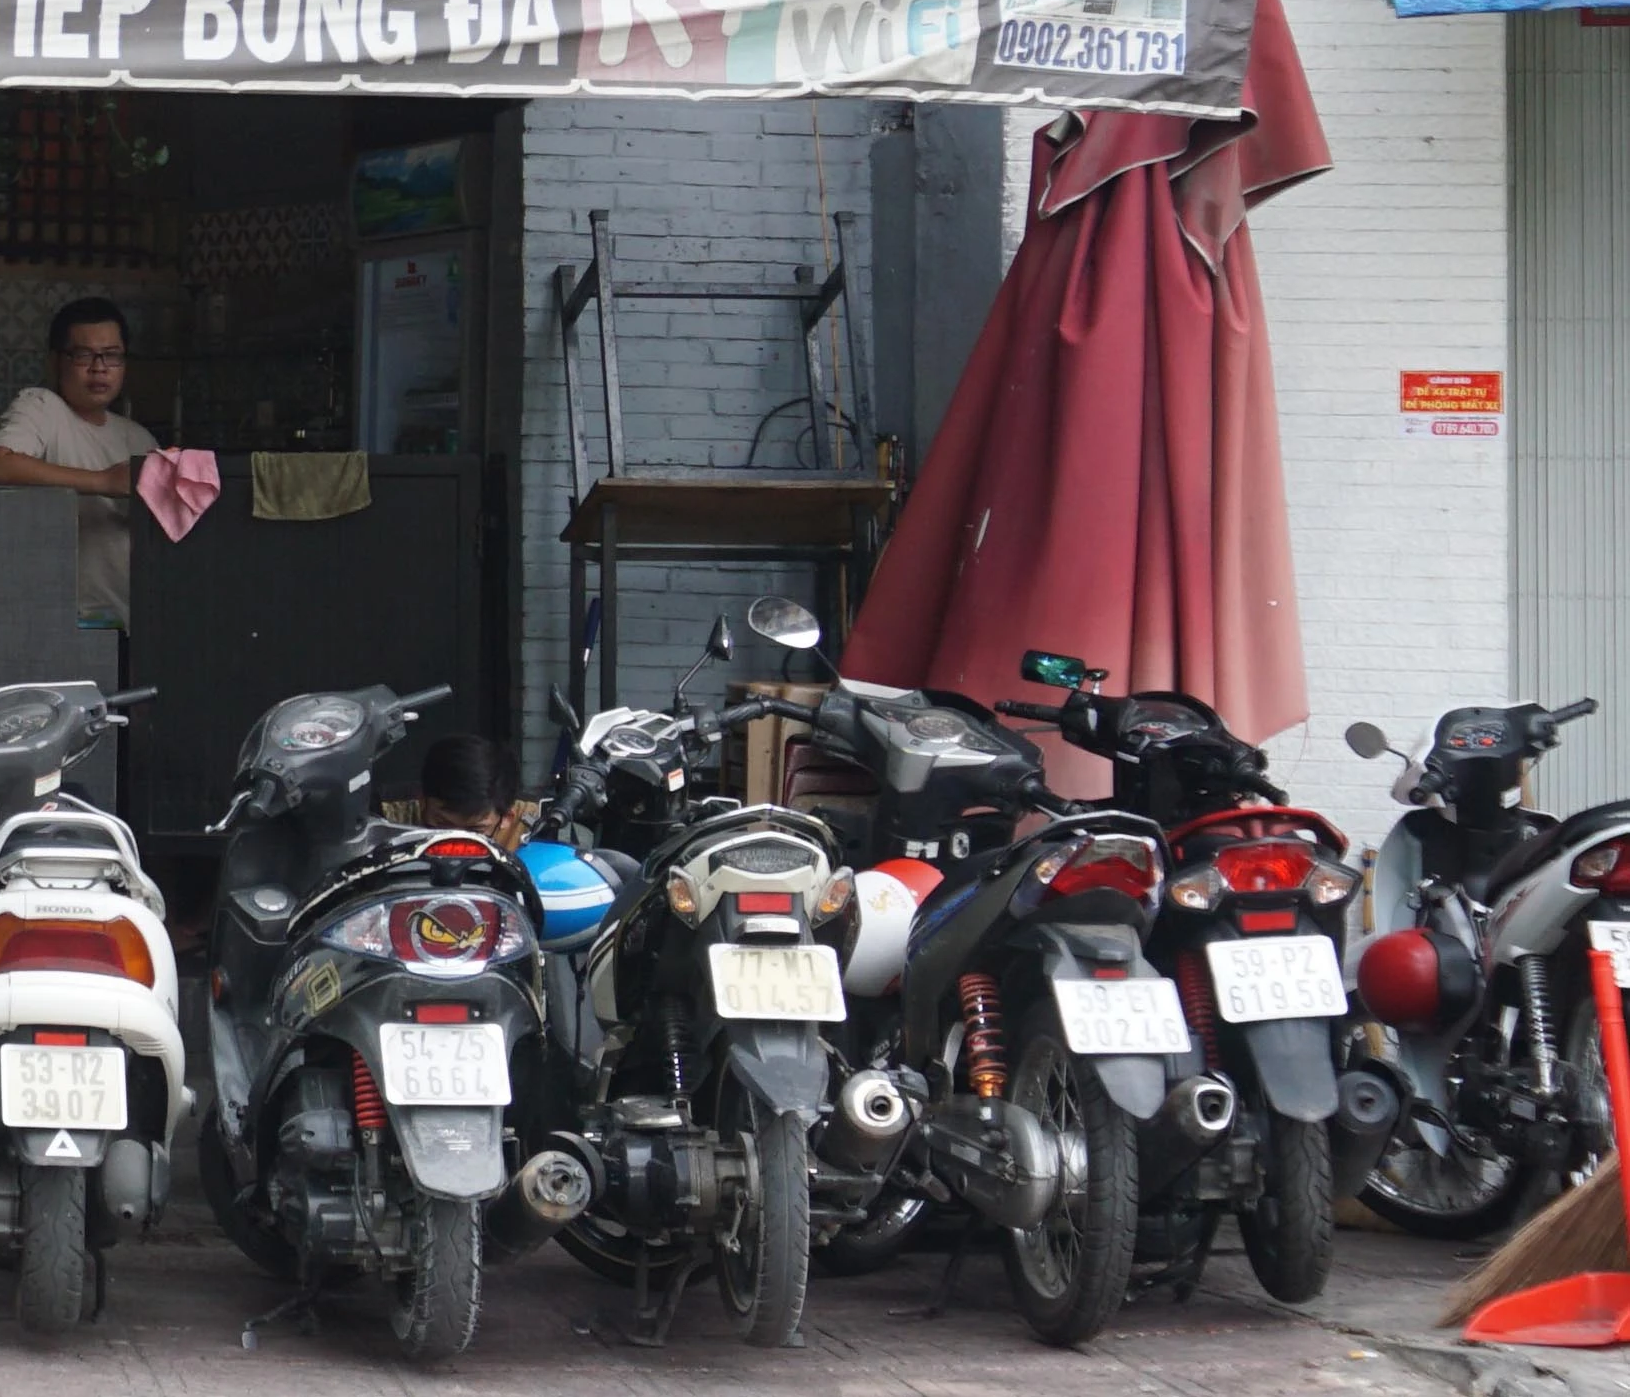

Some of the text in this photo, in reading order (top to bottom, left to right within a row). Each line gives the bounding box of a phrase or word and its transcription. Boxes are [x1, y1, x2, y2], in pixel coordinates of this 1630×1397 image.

[998, 19, 1185, 73] 0902.361.731
[36, 904, 94, 915] HONDA
[1231, 946, 1316, 978] 59-P2
[20, 1052, 105, 1085] 53-R2
[405, 1066, 489, 1097] 6664
[22, 1088, 105, 1121] 3907
